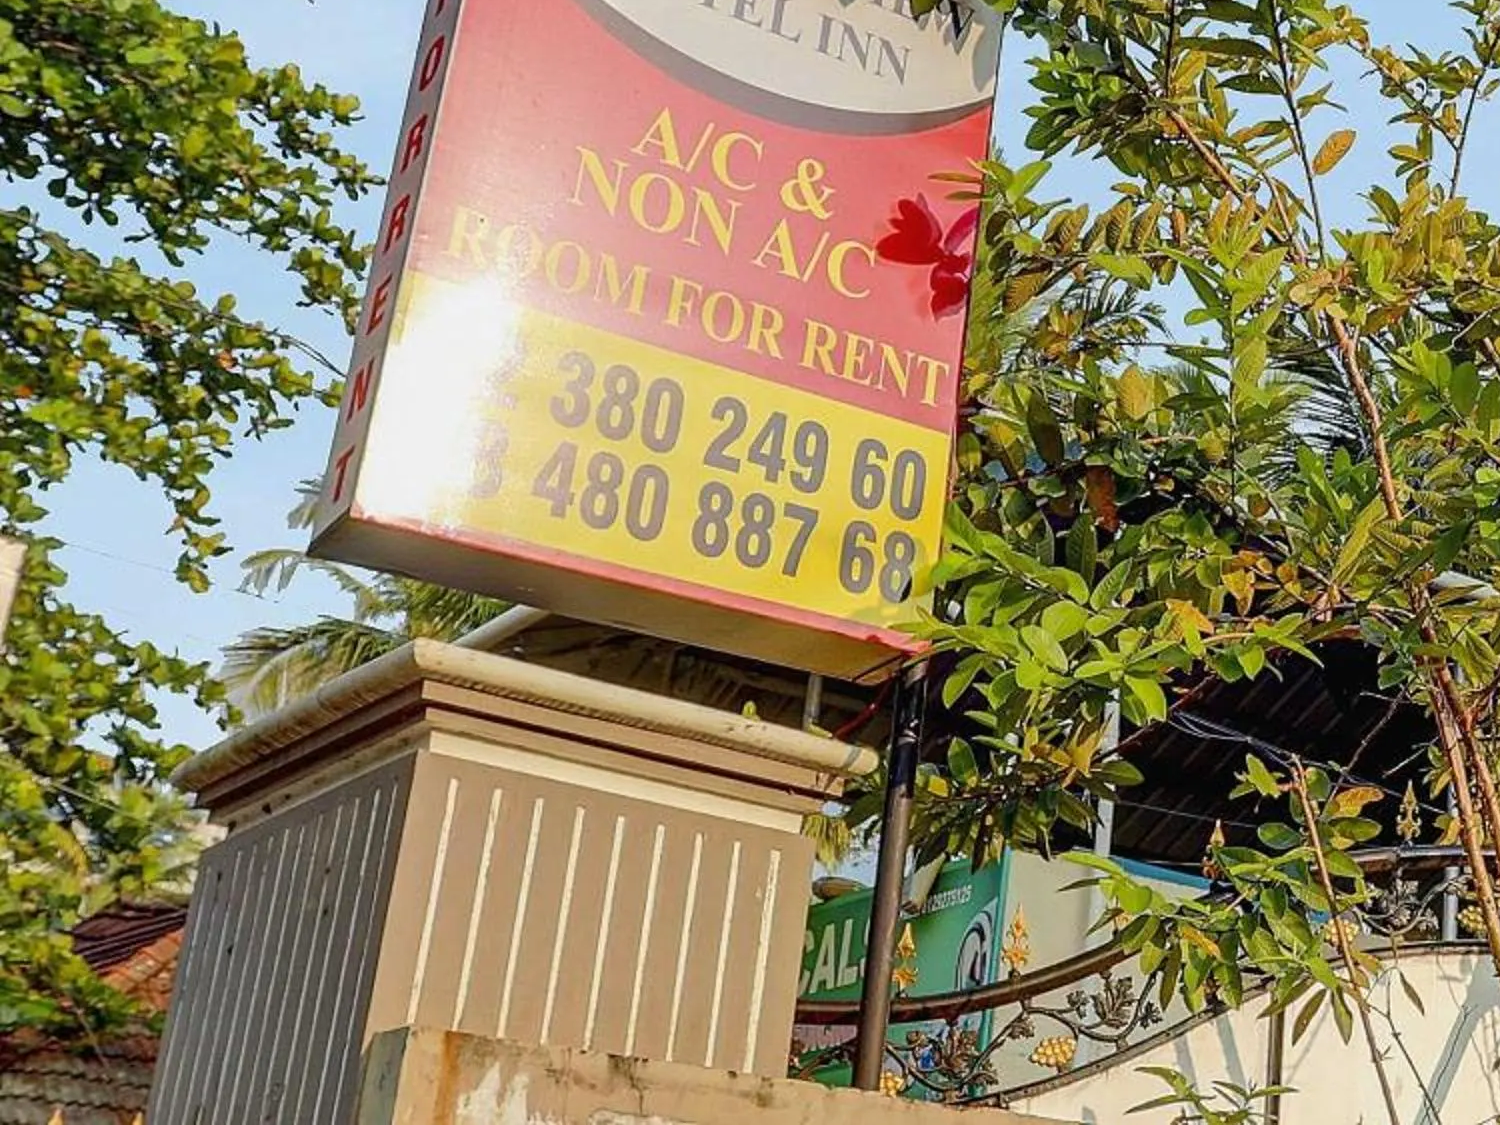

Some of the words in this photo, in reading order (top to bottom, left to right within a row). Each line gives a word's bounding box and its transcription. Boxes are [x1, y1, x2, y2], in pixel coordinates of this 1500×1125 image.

[815, 13, 911, 85] INN
[569, 145, 741, 256] NON
[752, 219, 877, 299] A/C
[632, 107, 763, 191] A/C
[780, 157, 837, 221] &
[442, 204, 647, 318] ROOM
[662, 277, 784, 359] FOR
[800, 323, 950, 408] RENT
[549, 351, 685, 454] 380
[703, 396, 829, 494] 249
[850, 438, 927, 522] 60
[532, 441, 669, 542] 480
[692, 481, 820, 578] 887
[838, 520, 917, 604] 68
[800, 917, 872, 995] AL
